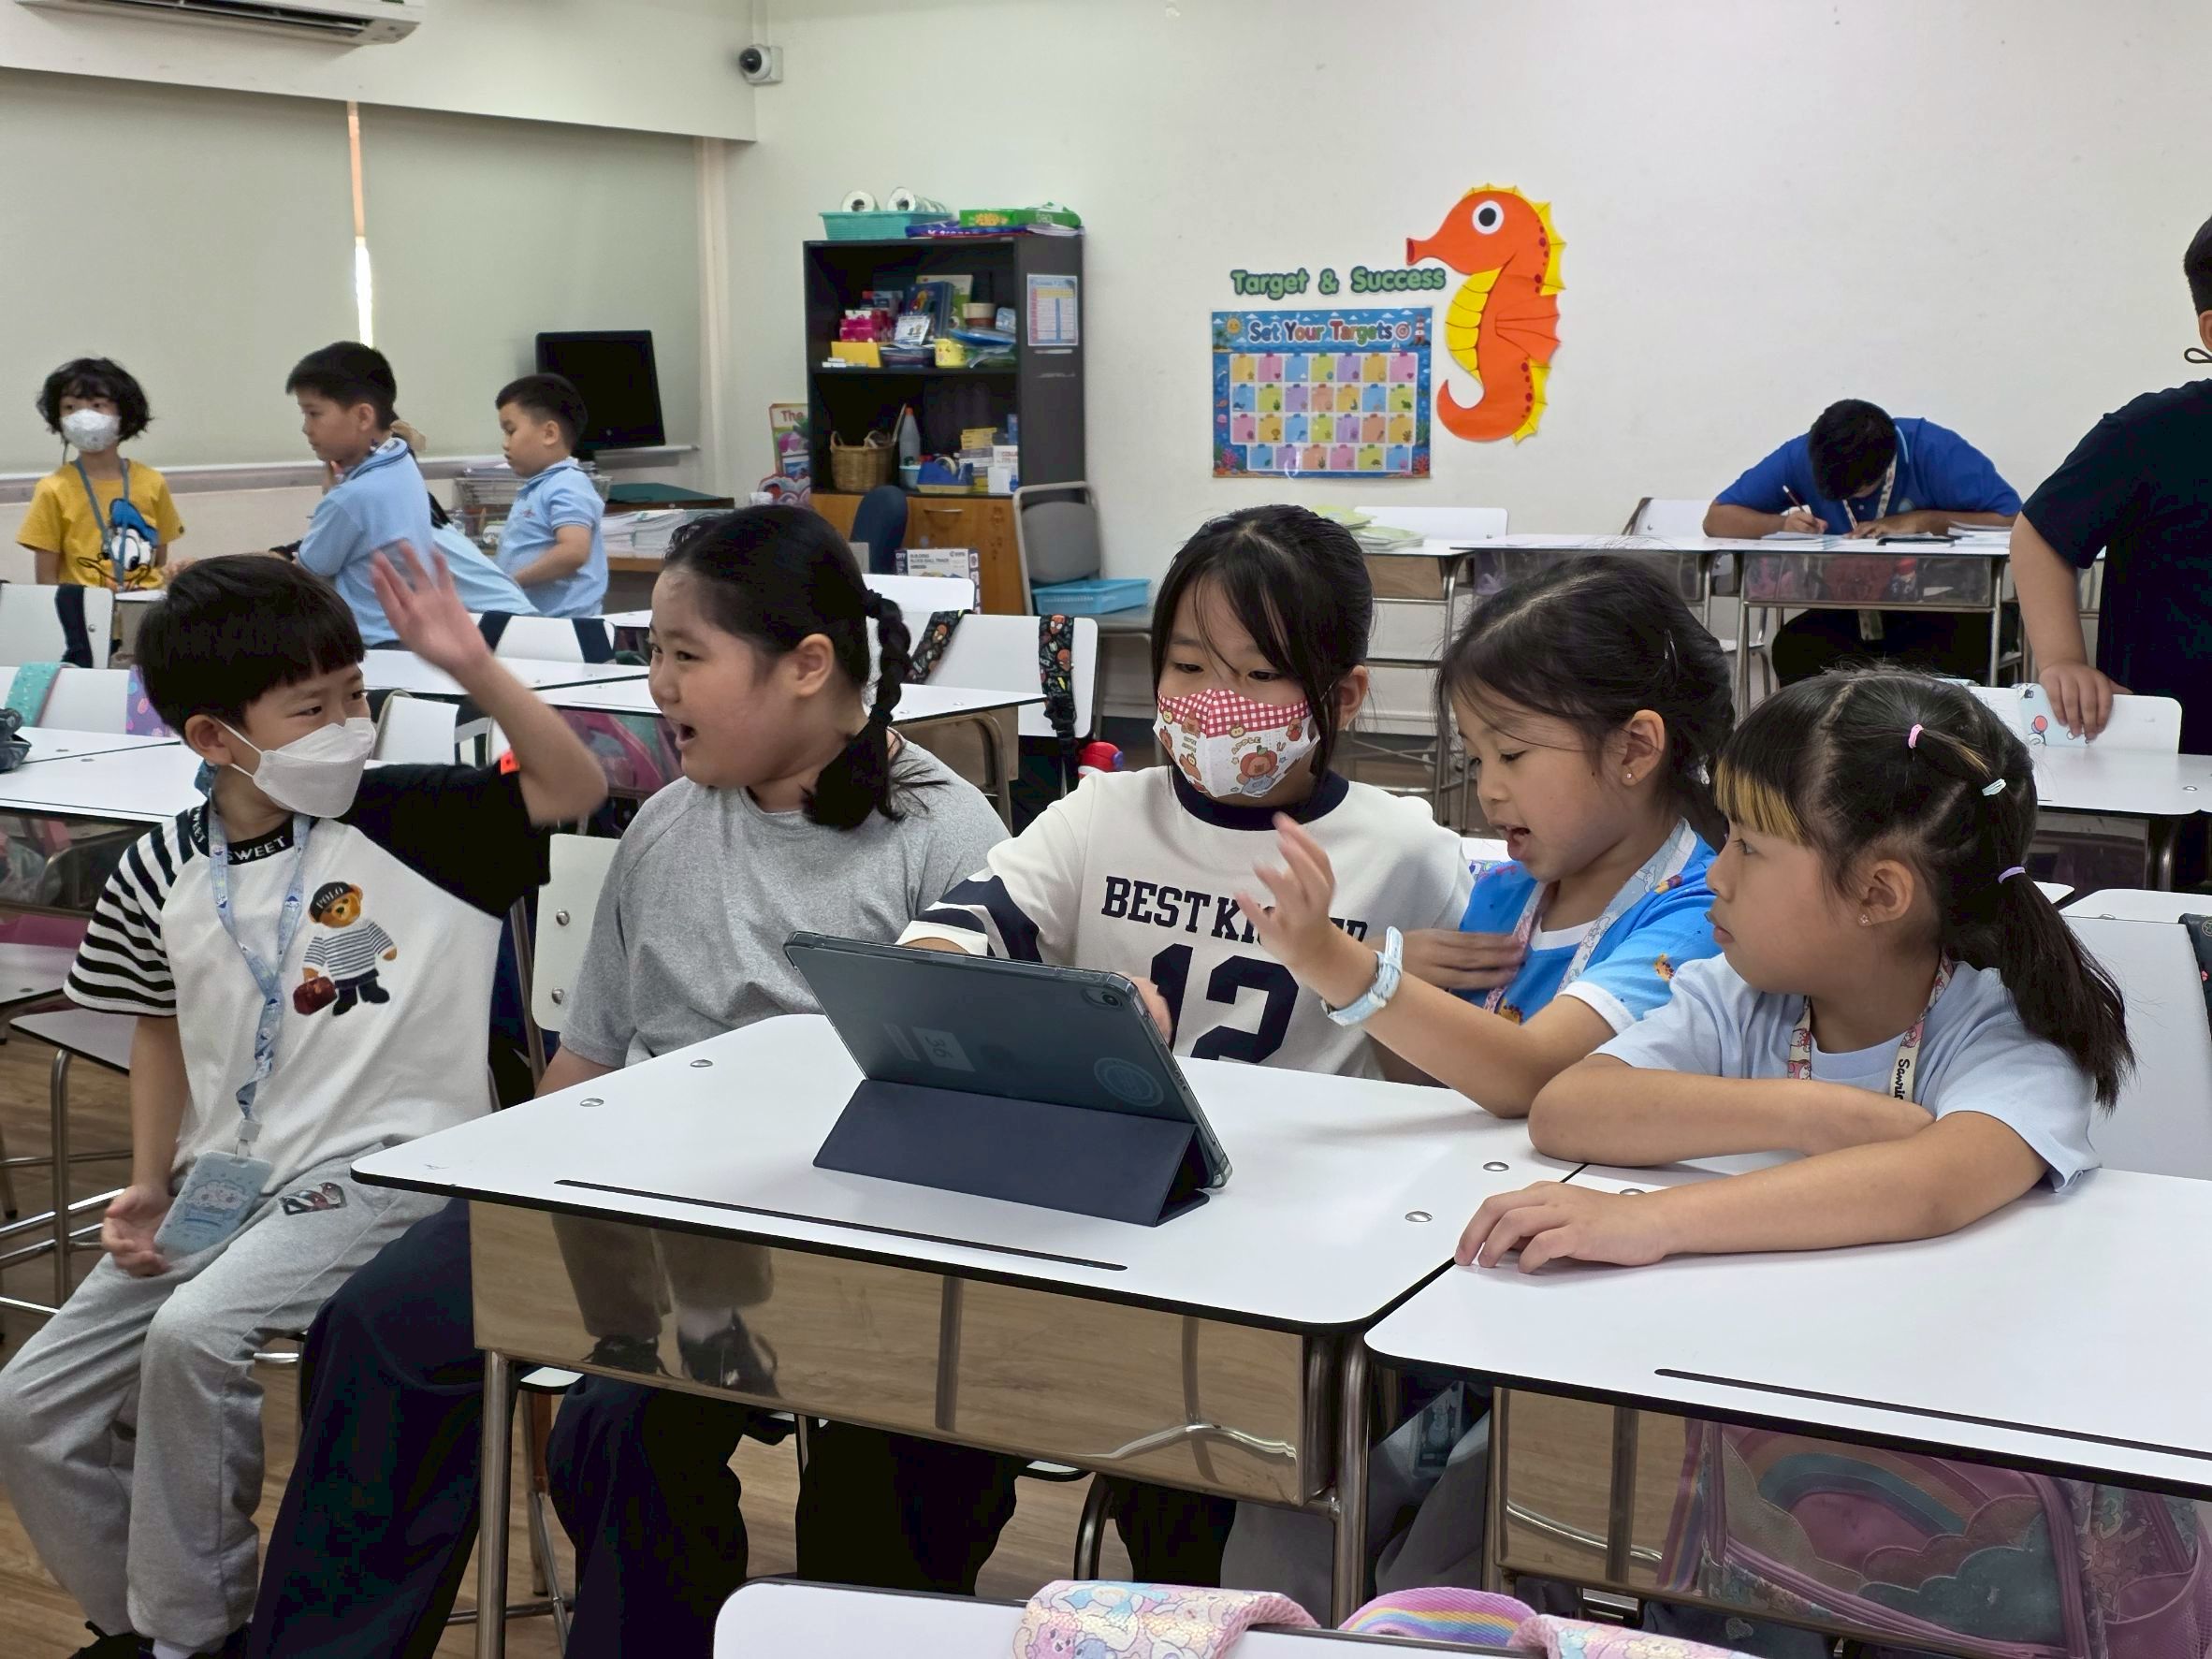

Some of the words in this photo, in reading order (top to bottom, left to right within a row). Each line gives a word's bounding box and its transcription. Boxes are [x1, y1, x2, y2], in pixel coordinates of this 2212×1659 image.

[1230, 268, 1310, 299] Target
[1318, 269, 1339, 295] &
[1351, 266, 1446, 293] Success
[1248, 320, 1281, 342] Set
[1283, 320, 1326, 342] Your
[1329, 319, 1393, 346] Targets
[316, 886, 344, 910] POLO
[1101, 875, 1210, 934] BEST
[1150, 942, 1299, 1064] 12
